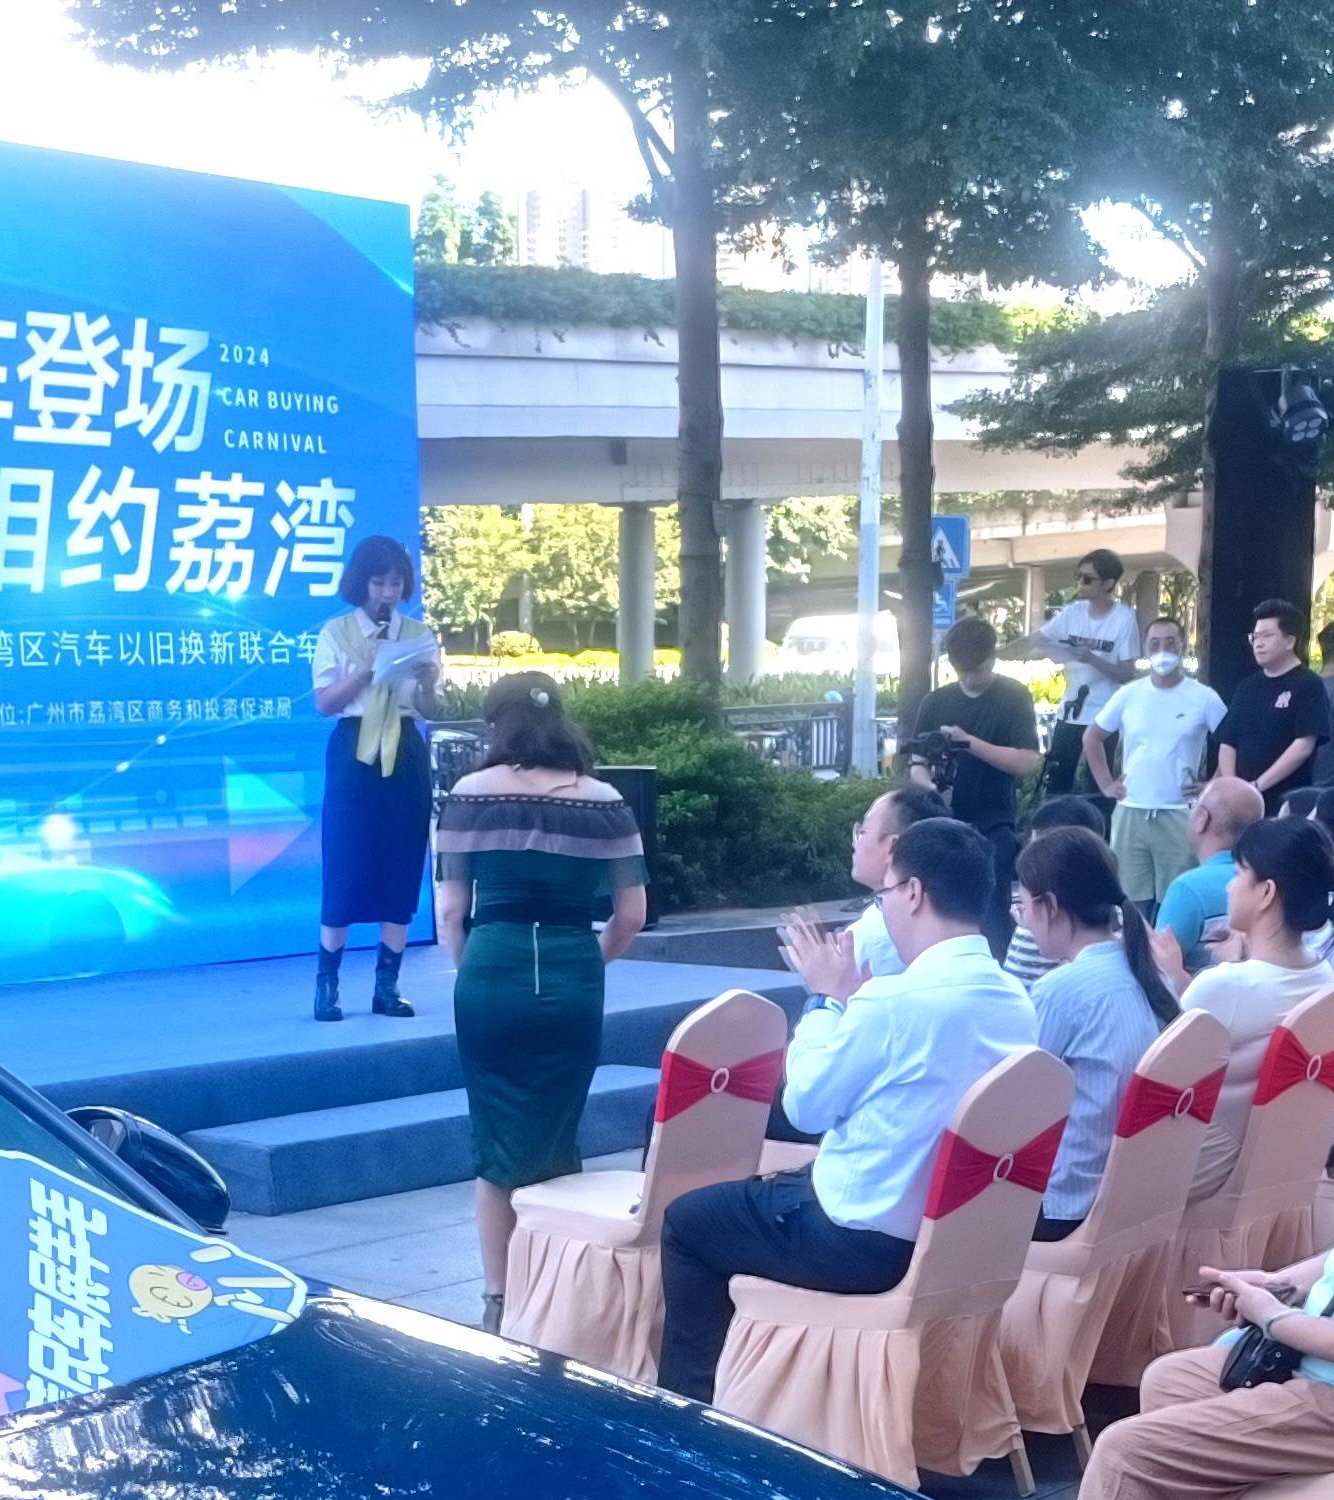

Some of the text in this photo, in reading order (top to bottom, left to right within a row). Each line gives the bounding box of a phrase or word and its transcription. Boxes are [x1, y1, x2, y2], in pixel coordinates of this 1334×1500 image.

[219, 343, 270, 368] 2024
[221, 387, 340, 415] CAR BUYING
[224, 428, 327, 455] CARNIVAL
